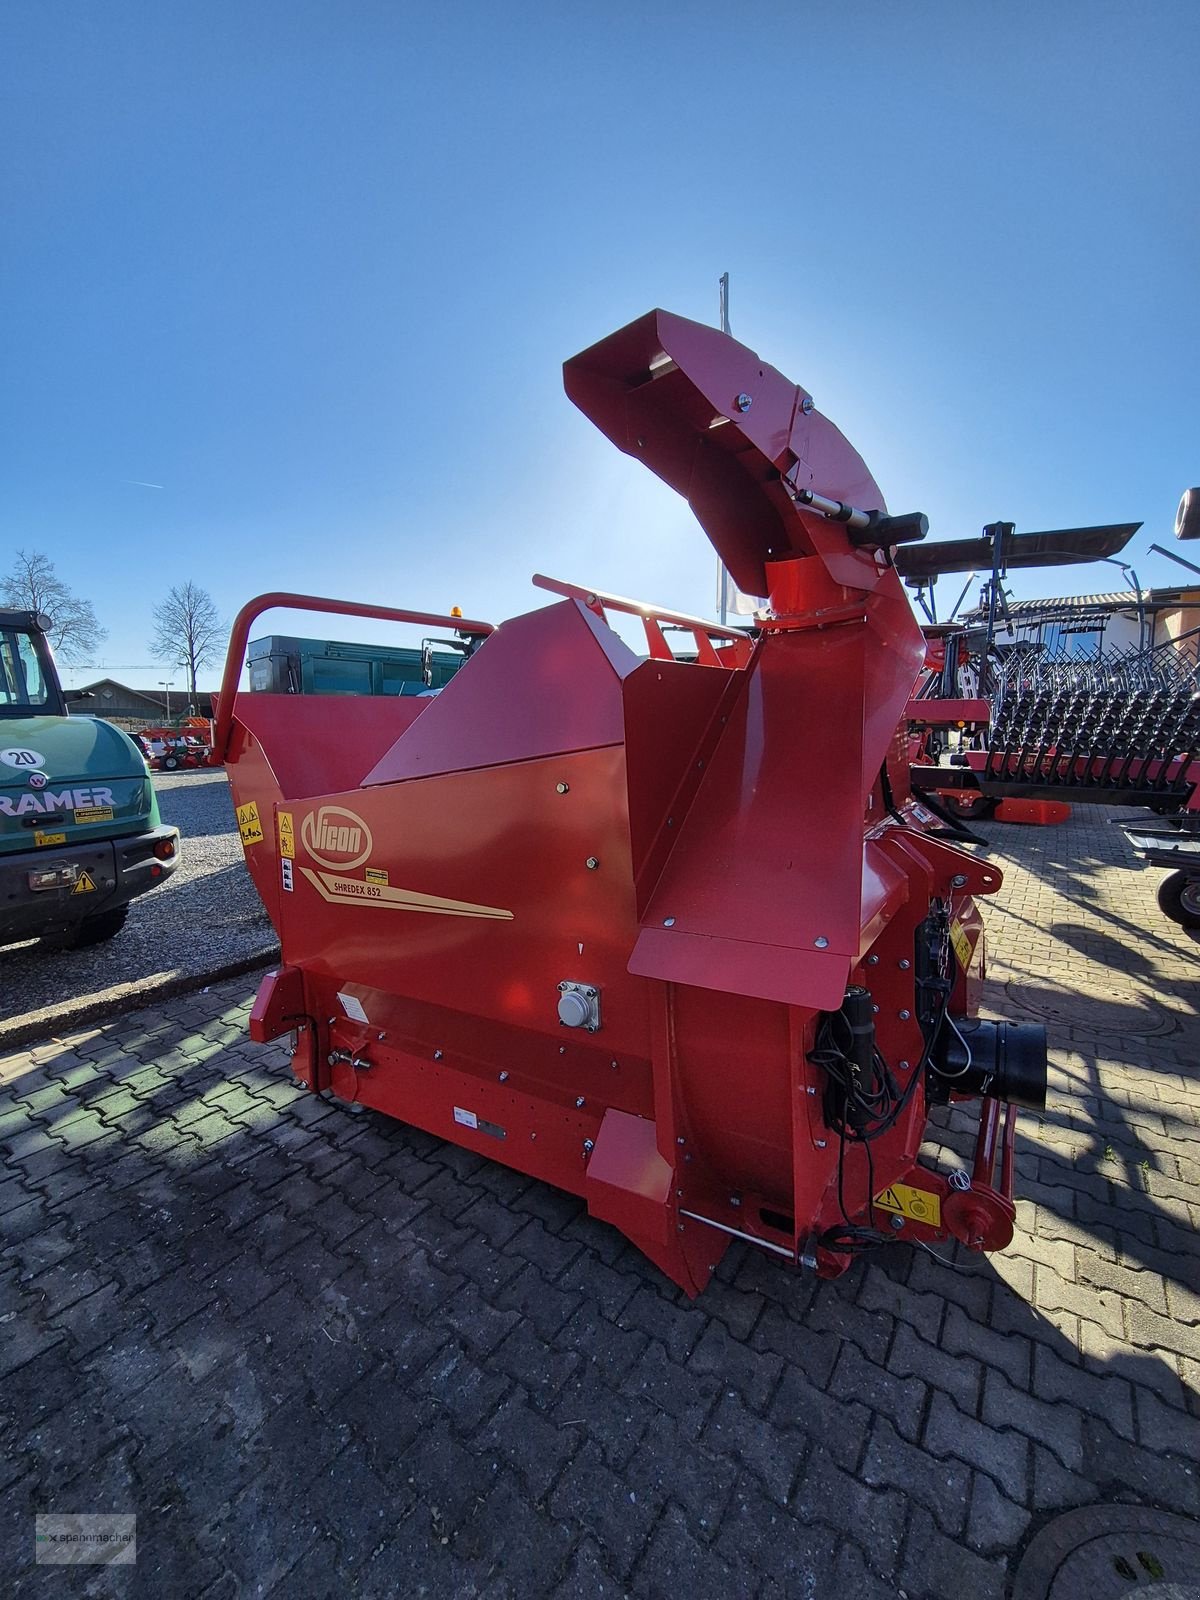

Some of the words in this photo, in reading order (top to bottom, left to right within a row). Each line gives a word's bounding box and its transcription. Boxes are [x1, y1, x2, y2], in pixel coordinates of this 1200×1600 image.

[8, 751, 37, 765] 20
[310, 806, 361, 853] Vicon
[334, 882, 365, 894] SHREDEX
[366, 887, 381, 896] 852
